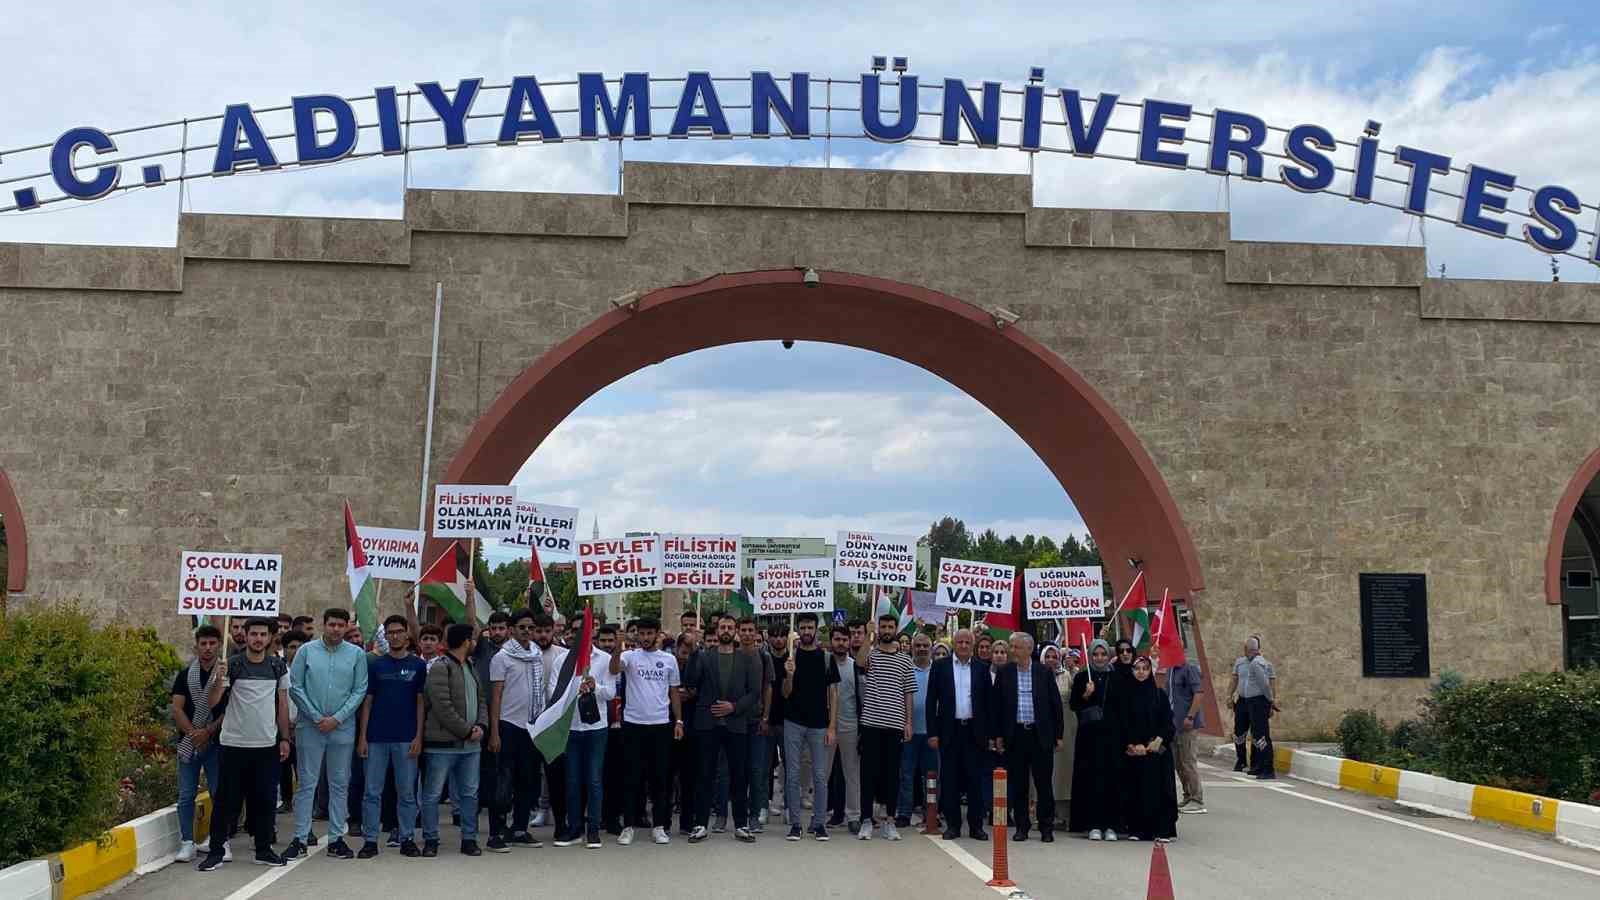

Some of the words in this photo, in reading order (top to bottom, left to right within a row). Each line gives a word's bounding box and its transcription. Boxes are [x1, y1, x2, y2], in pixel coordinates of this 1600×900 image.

[0, 127, 165, 211] .C.
[213, 71, 811, 176] ADIYAMAN
[439, 492, 513, 505] FİLİSTİN'DE
[438, 507, 512, 518] OLANLARA
[438, 519, 511, 530] SUSMAYIN
[515, 512, 574, 530] İVİLLERİ
[519, 525, 558, 535] HEDEF
[848, 532, 876, 541] İSRAİL
[358, 537, 419, 554] OYKIRIMA
[579, 540, 655, 556] DEVLET
[664, 537, 737, 552] FİLİSTİN
[846, 540, 908, 552] DÜNYANIN
[839, 549, 868, 559] GÖZÜ
[870, 552, 913, 562] ÖNÜNDE
[186, 556, 278, 572] ÇOCUKLAR
[377, 556, 416, 570] YUMMA
[582, 556, 656, 576] DEĞİL,
[768, 562, 790, 570] KATİL
[839, 558, 878, 570] SAVAŞ
[881, 562, 913, 573] SUÇU
[664, 570, 735, 585] DEĞİLİZ
[758, 570, 830, 580] SİYONİSTLER
[858, 570, 907, 582] İŞLİYOR
[942, 563, 1012, 580] GAZZE'DE
[1040, 570, 1086, 580] UĞRUNA
[184, 574, 276, 594] ÖLÜRKEN
[582, 574, 658, 591] TERÖRİST
[768, 580, 802, 590] KADIN
[804, 580, 820, 588] VE
[940, 574, 1012, 592] SOYKIRIM
[761, 590, 826, 600] ÇOCUKLARI
[946, 587, 1003, 609] VAR!
[182, 596, 276, 612] SUSULMAZ
[760, 601, 825, 611] ÖLDÜRÜYOR
[1031, 596, 1100, 610] ÖLDÜĞÜN
[1065, 608, 1102, 616] SENİNDİR
[638, 669, 664, 678] QATAR
